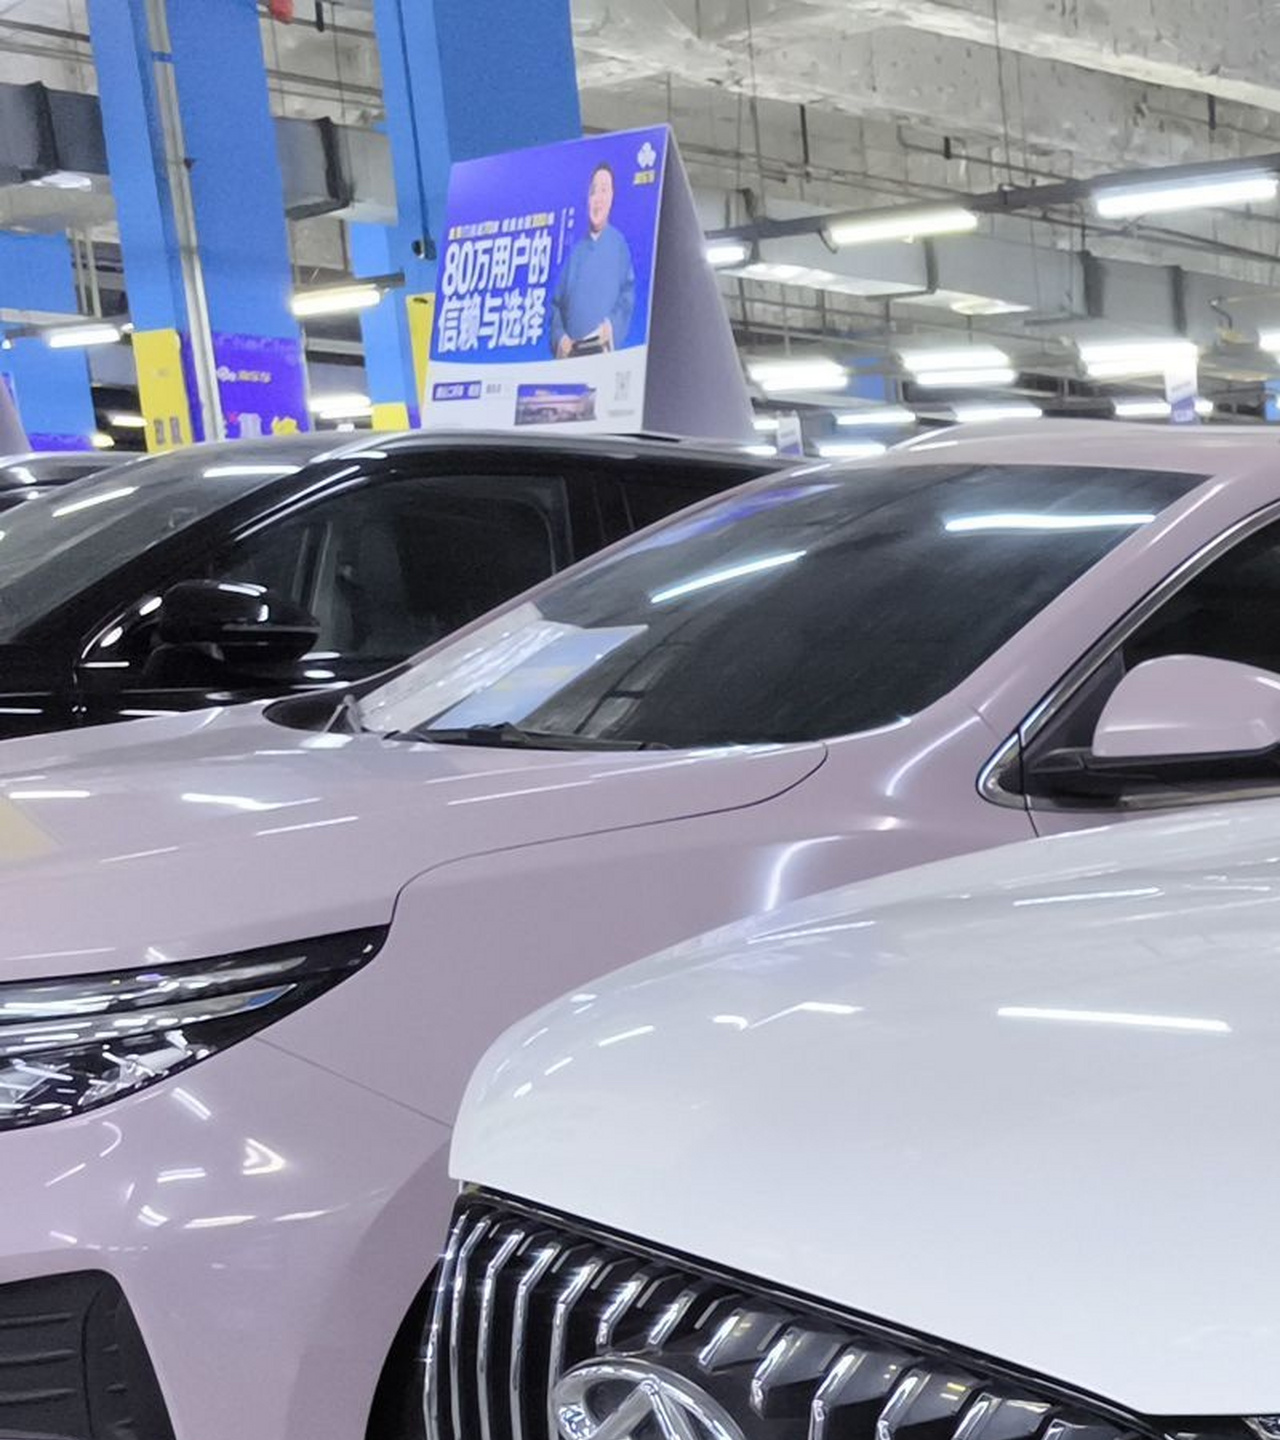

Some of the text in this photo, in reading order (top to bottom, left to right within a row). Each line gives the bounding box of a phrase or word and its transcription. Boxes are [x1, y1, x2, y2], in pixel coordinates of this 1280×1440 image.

[441, 229, 552, 297] 80万用户的
[437, 287, 547, 353] 信赖与选择
